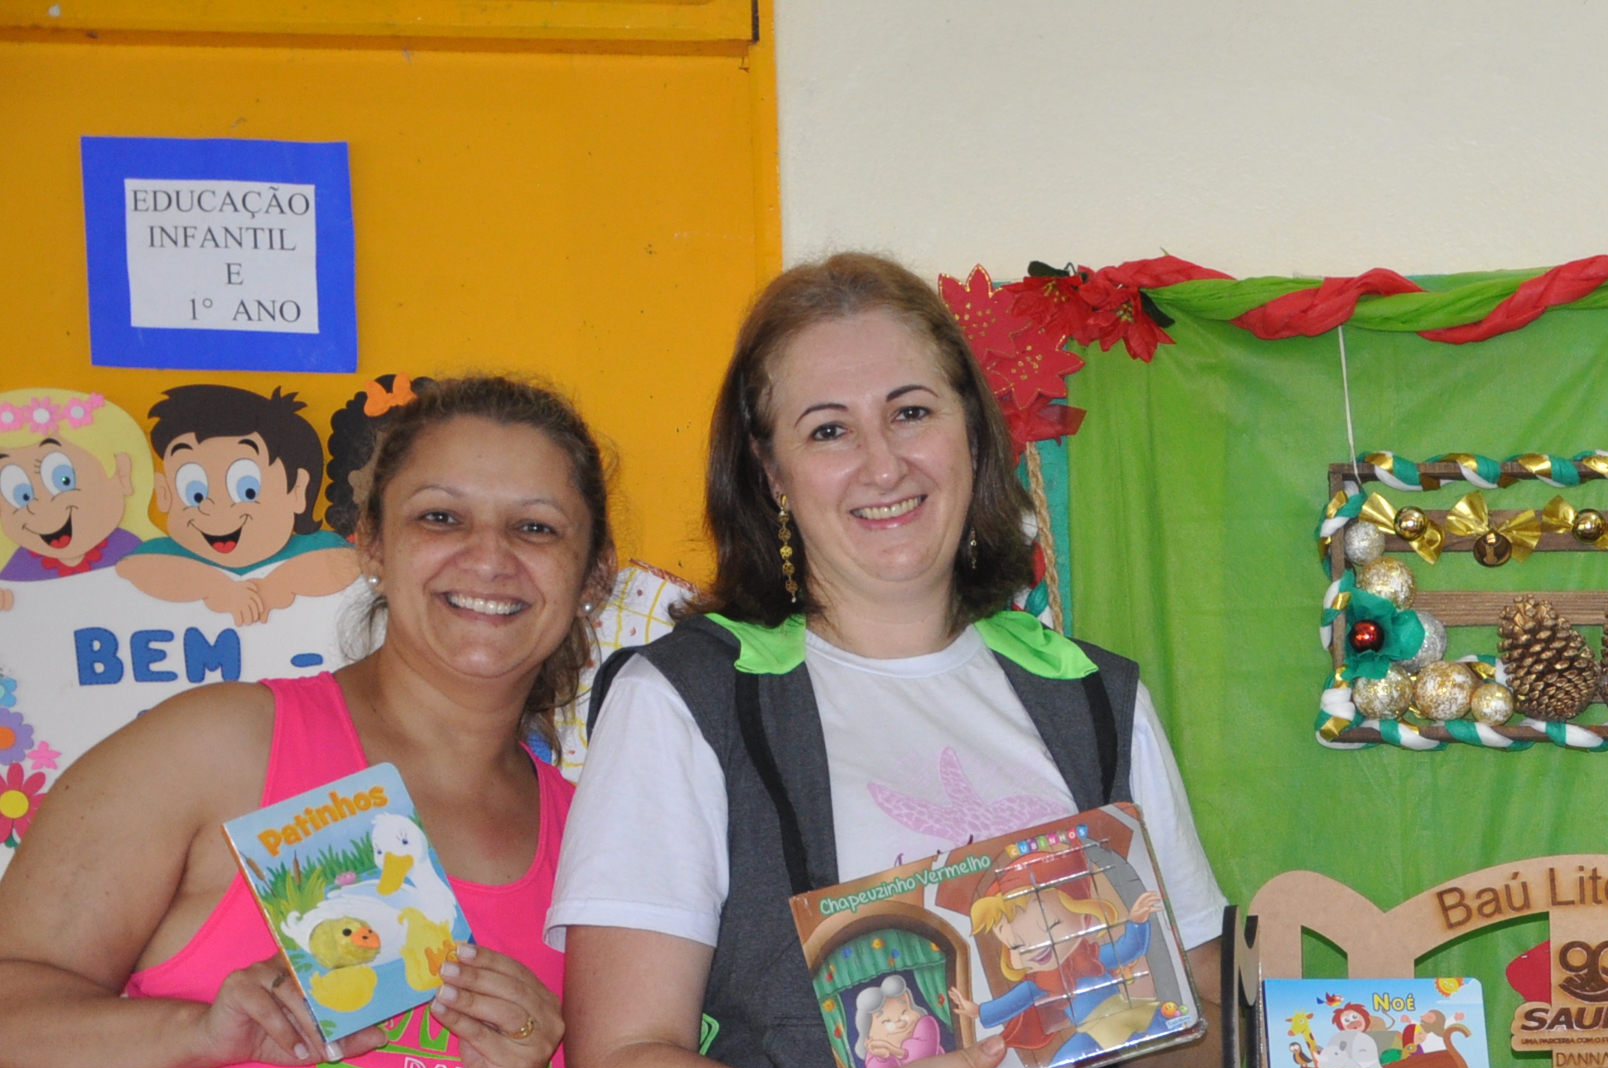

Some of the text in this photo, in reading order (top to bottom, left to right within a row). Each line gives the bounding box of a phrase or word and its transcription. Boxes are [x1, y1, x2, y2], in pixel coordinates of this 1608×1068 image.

[131, 185, 311, 220] EDUCAÇÃO
[147, 224, 297, 251] INFANTIL
[224, 261, 245, 286] E
[231, 298, 302, 323] ANO
[73, 626, 242, 686] BEM
[257, 785, 390, 858] Patinhos
[1009, 824, 1089, 857] CUBINHOS
[819, 854, 993, 916] Chapeuzinho Vermelho
[1435, 871, 1532, 930] Baú
